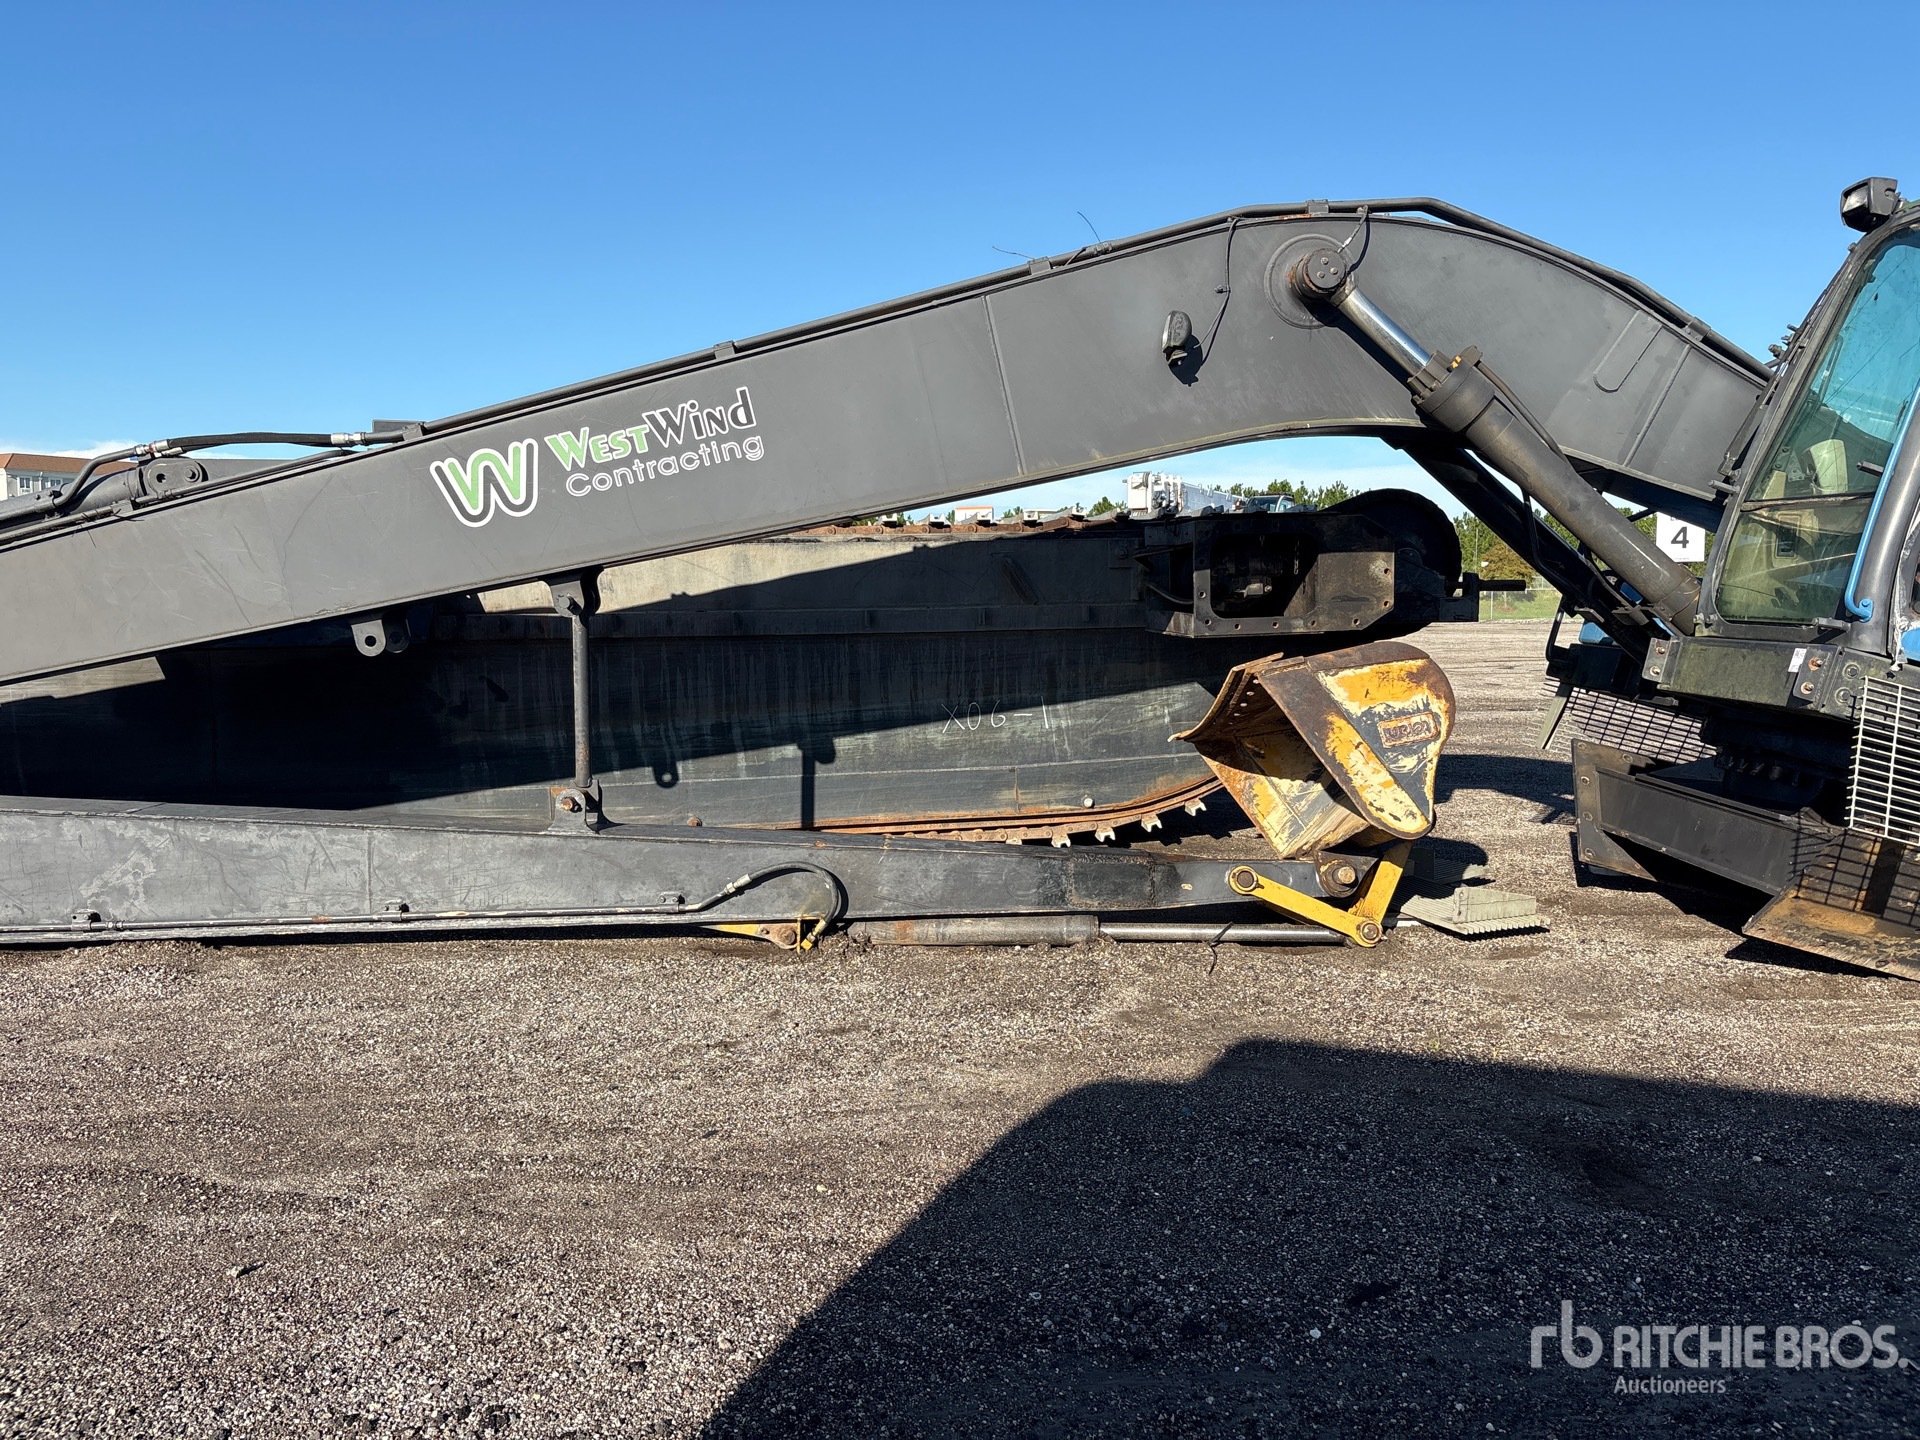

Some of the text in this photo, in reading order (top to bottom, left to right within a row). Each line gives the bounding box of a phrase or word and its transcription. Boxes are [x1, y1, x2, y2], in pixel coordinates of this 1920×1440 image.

[565, 435, 765, 497] Contracting
[1670, 526, 1690, 549] 4
[940, 695, 1050, 734] X06-1
